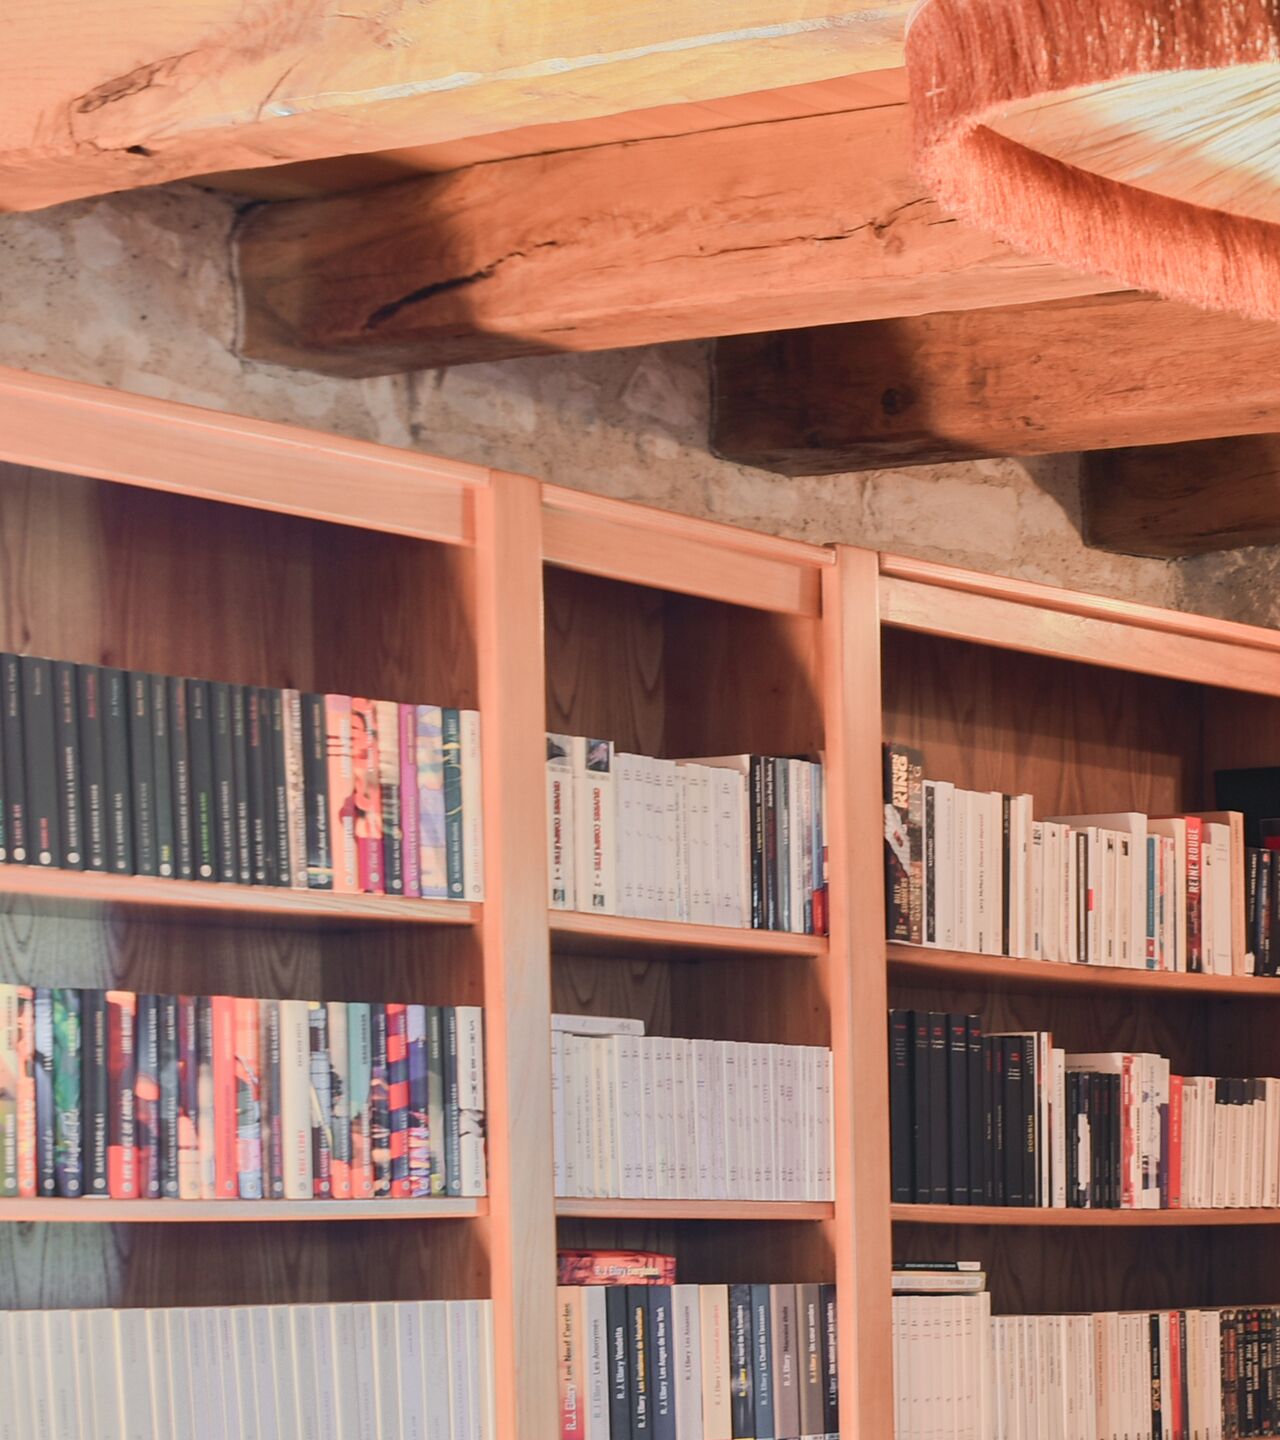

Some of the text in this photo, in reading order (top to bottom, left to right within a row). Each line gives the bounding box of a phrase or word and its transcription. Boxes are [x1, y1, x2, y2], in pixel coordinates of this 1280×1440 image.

[893, 755, 908, 808] KING
[1187, 828, 1200, 893] REINE ROUGE
[615, 1327, 624, 1360] Vendetta
[616, 1361, 625, 1382] Ellory
[783, 1354, 791, 1372] Ellory
[565, 1383, 576, 1410] Ellory
[617, 1391, 624, 1399] R.
[660, 1382, 668, 1399] Ellory
[637, 1396, 646, 1413] Ellory
[566, 1421, 576, 1430] R.
